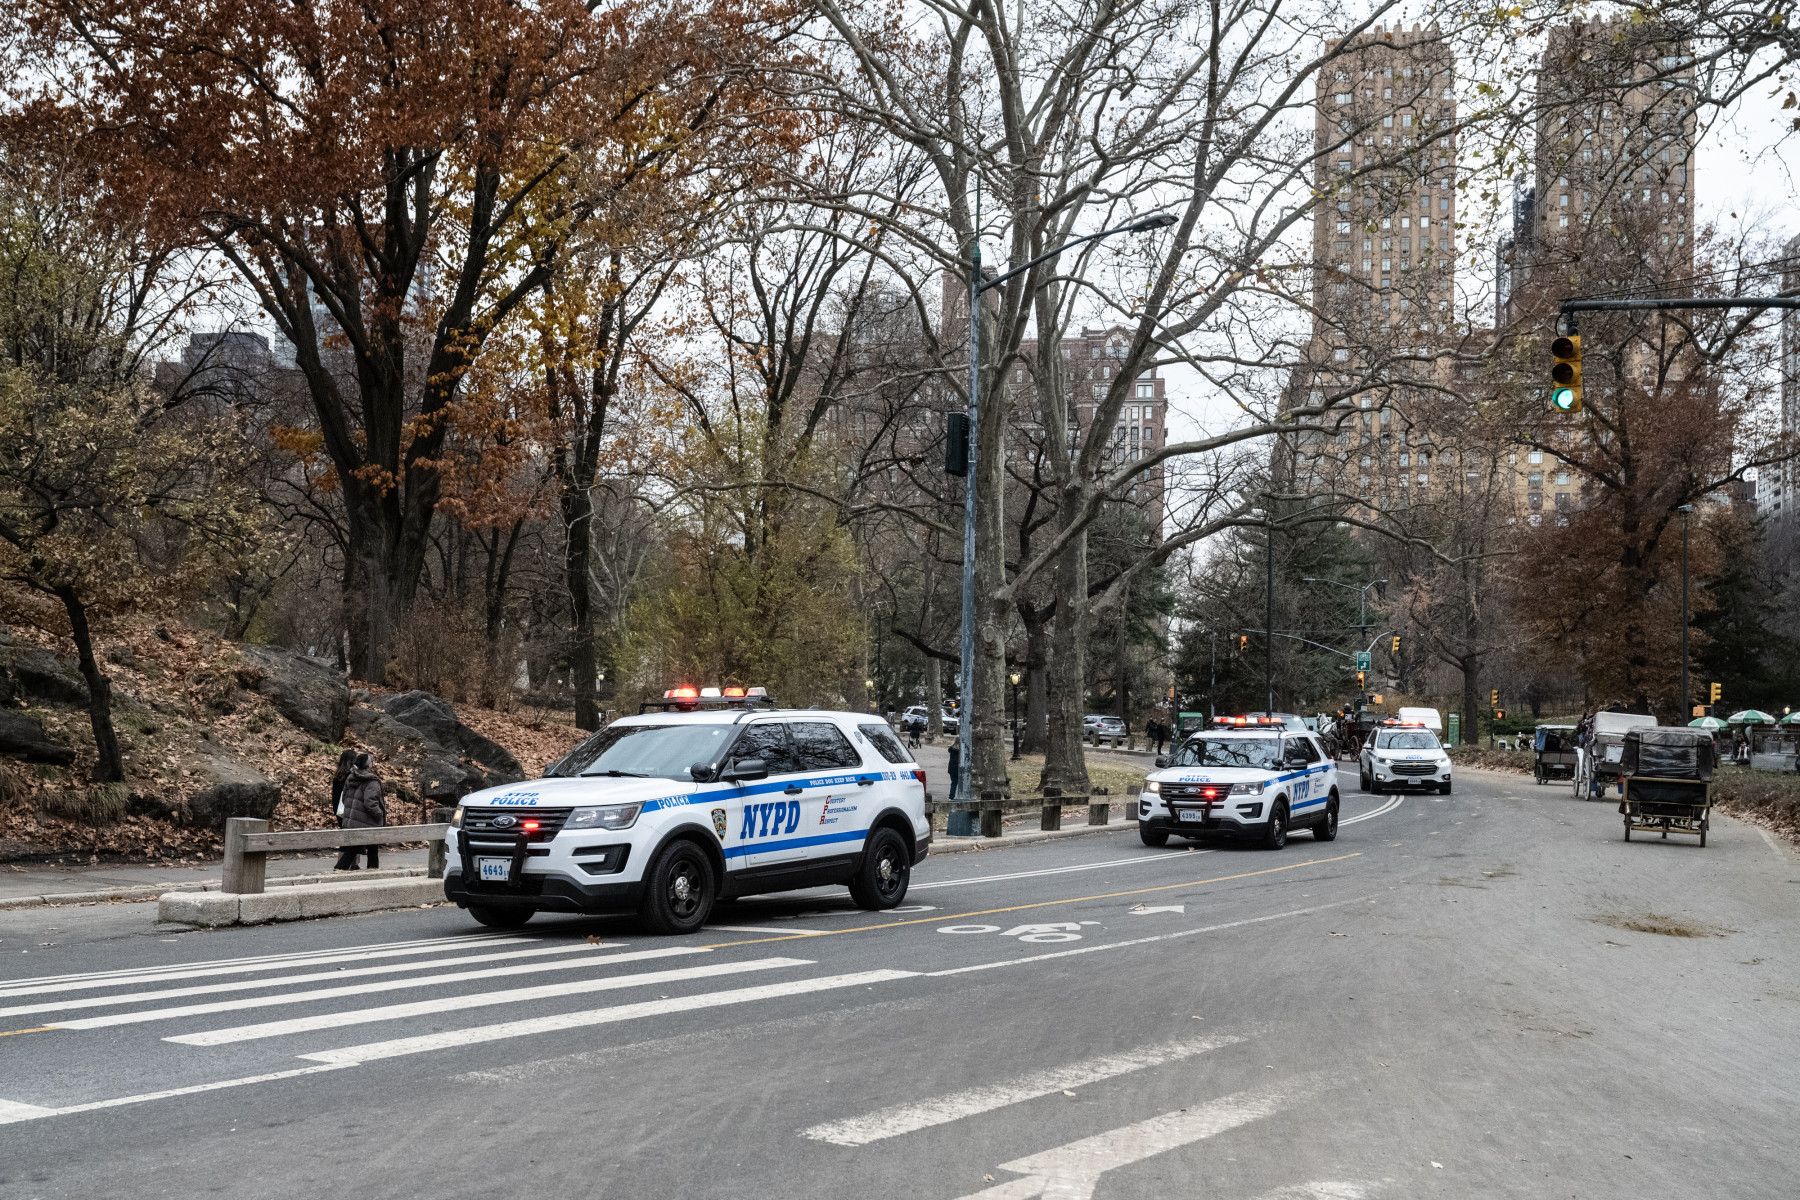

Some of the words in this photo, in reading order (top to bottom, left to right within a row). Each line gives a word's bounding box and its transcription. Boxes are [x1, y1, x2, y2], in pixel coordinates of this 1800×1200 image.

[1293, 780, 1310, 802] NYPD
[490, 797, 539, 806] POLICE
[658, 794, 690, 810] POLICE
[740, 800, 800, 840] NYPD
[483, 864, 503, 876] 4643
